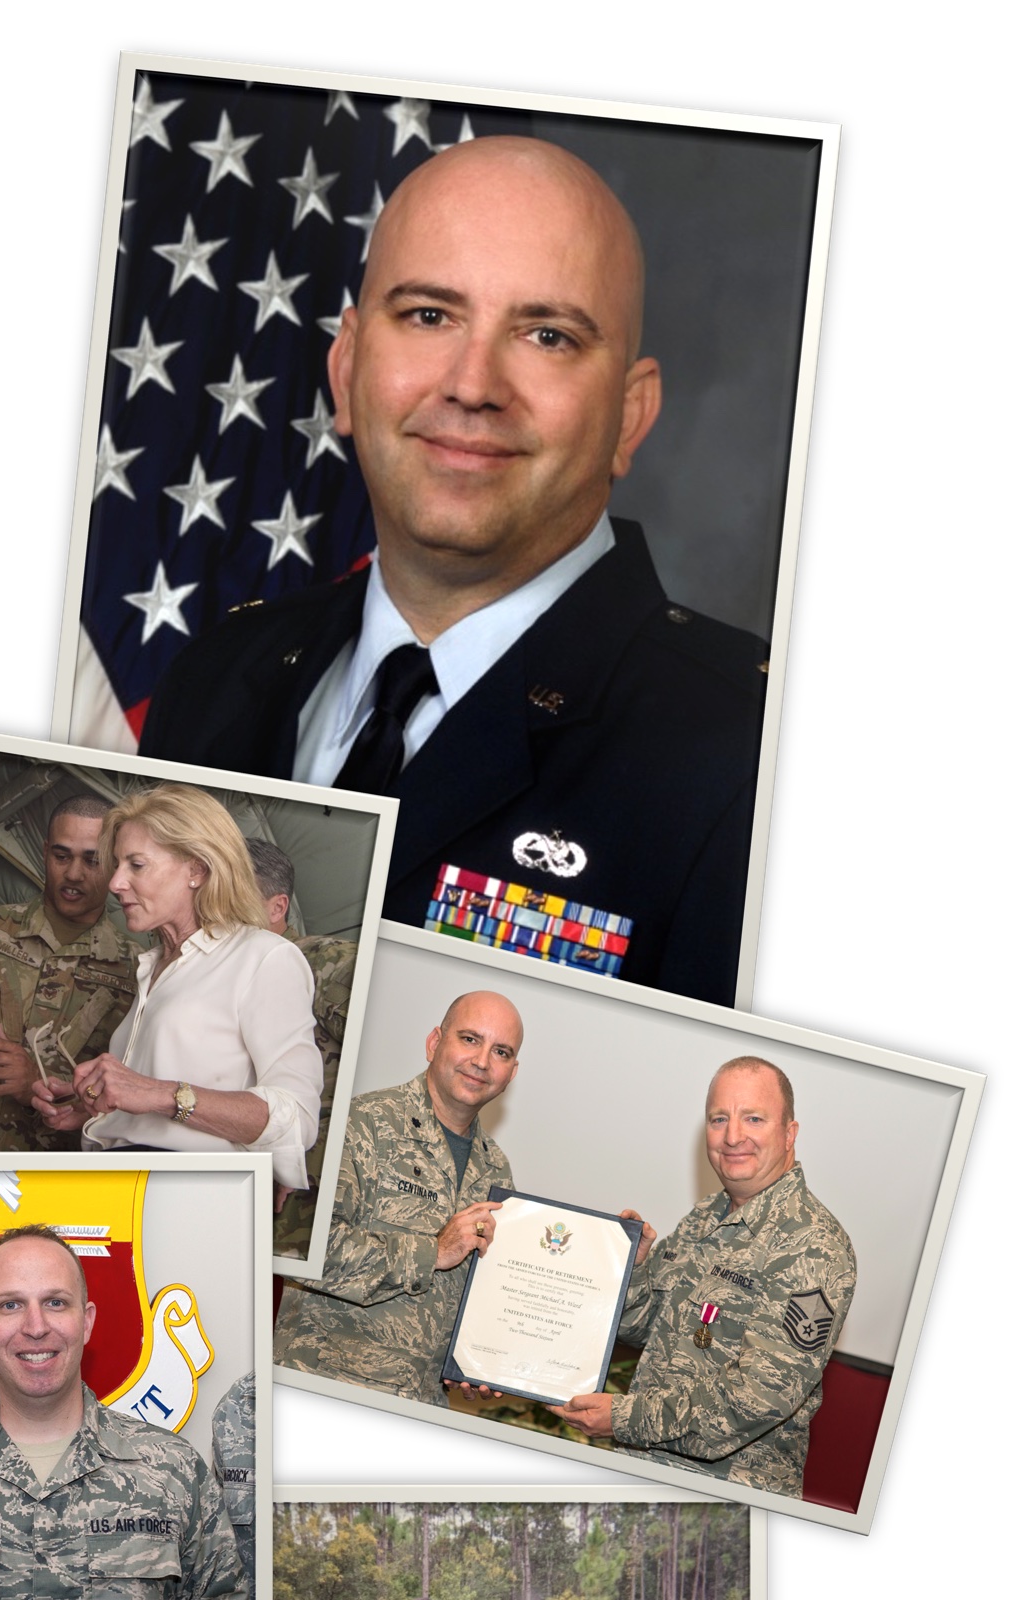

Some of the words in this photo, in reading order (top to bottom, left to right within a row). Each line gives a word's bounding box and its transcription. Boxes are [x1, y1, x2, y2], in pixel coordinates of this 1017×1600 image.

[398, 1180, 438, 1202] CENTINARO
[507, 1259, 545, 1273] CERTIFICATE
[555, 1270, 593, 1284] RETIREMENT
[500, 1285, 518, 1294] Master
[518, 1289, 539, 1299] Sergeant
[503, 1308, 524, 1317] UNITED
[524, 1313, 544, 1322] STATES
[554, 1320, 573, 1329] FORCE
[90, 1519, 112, 1533] U.S.
[115, 1518, 136, 1532] AIR
[139, 1518, 173, 1534] FORCE
